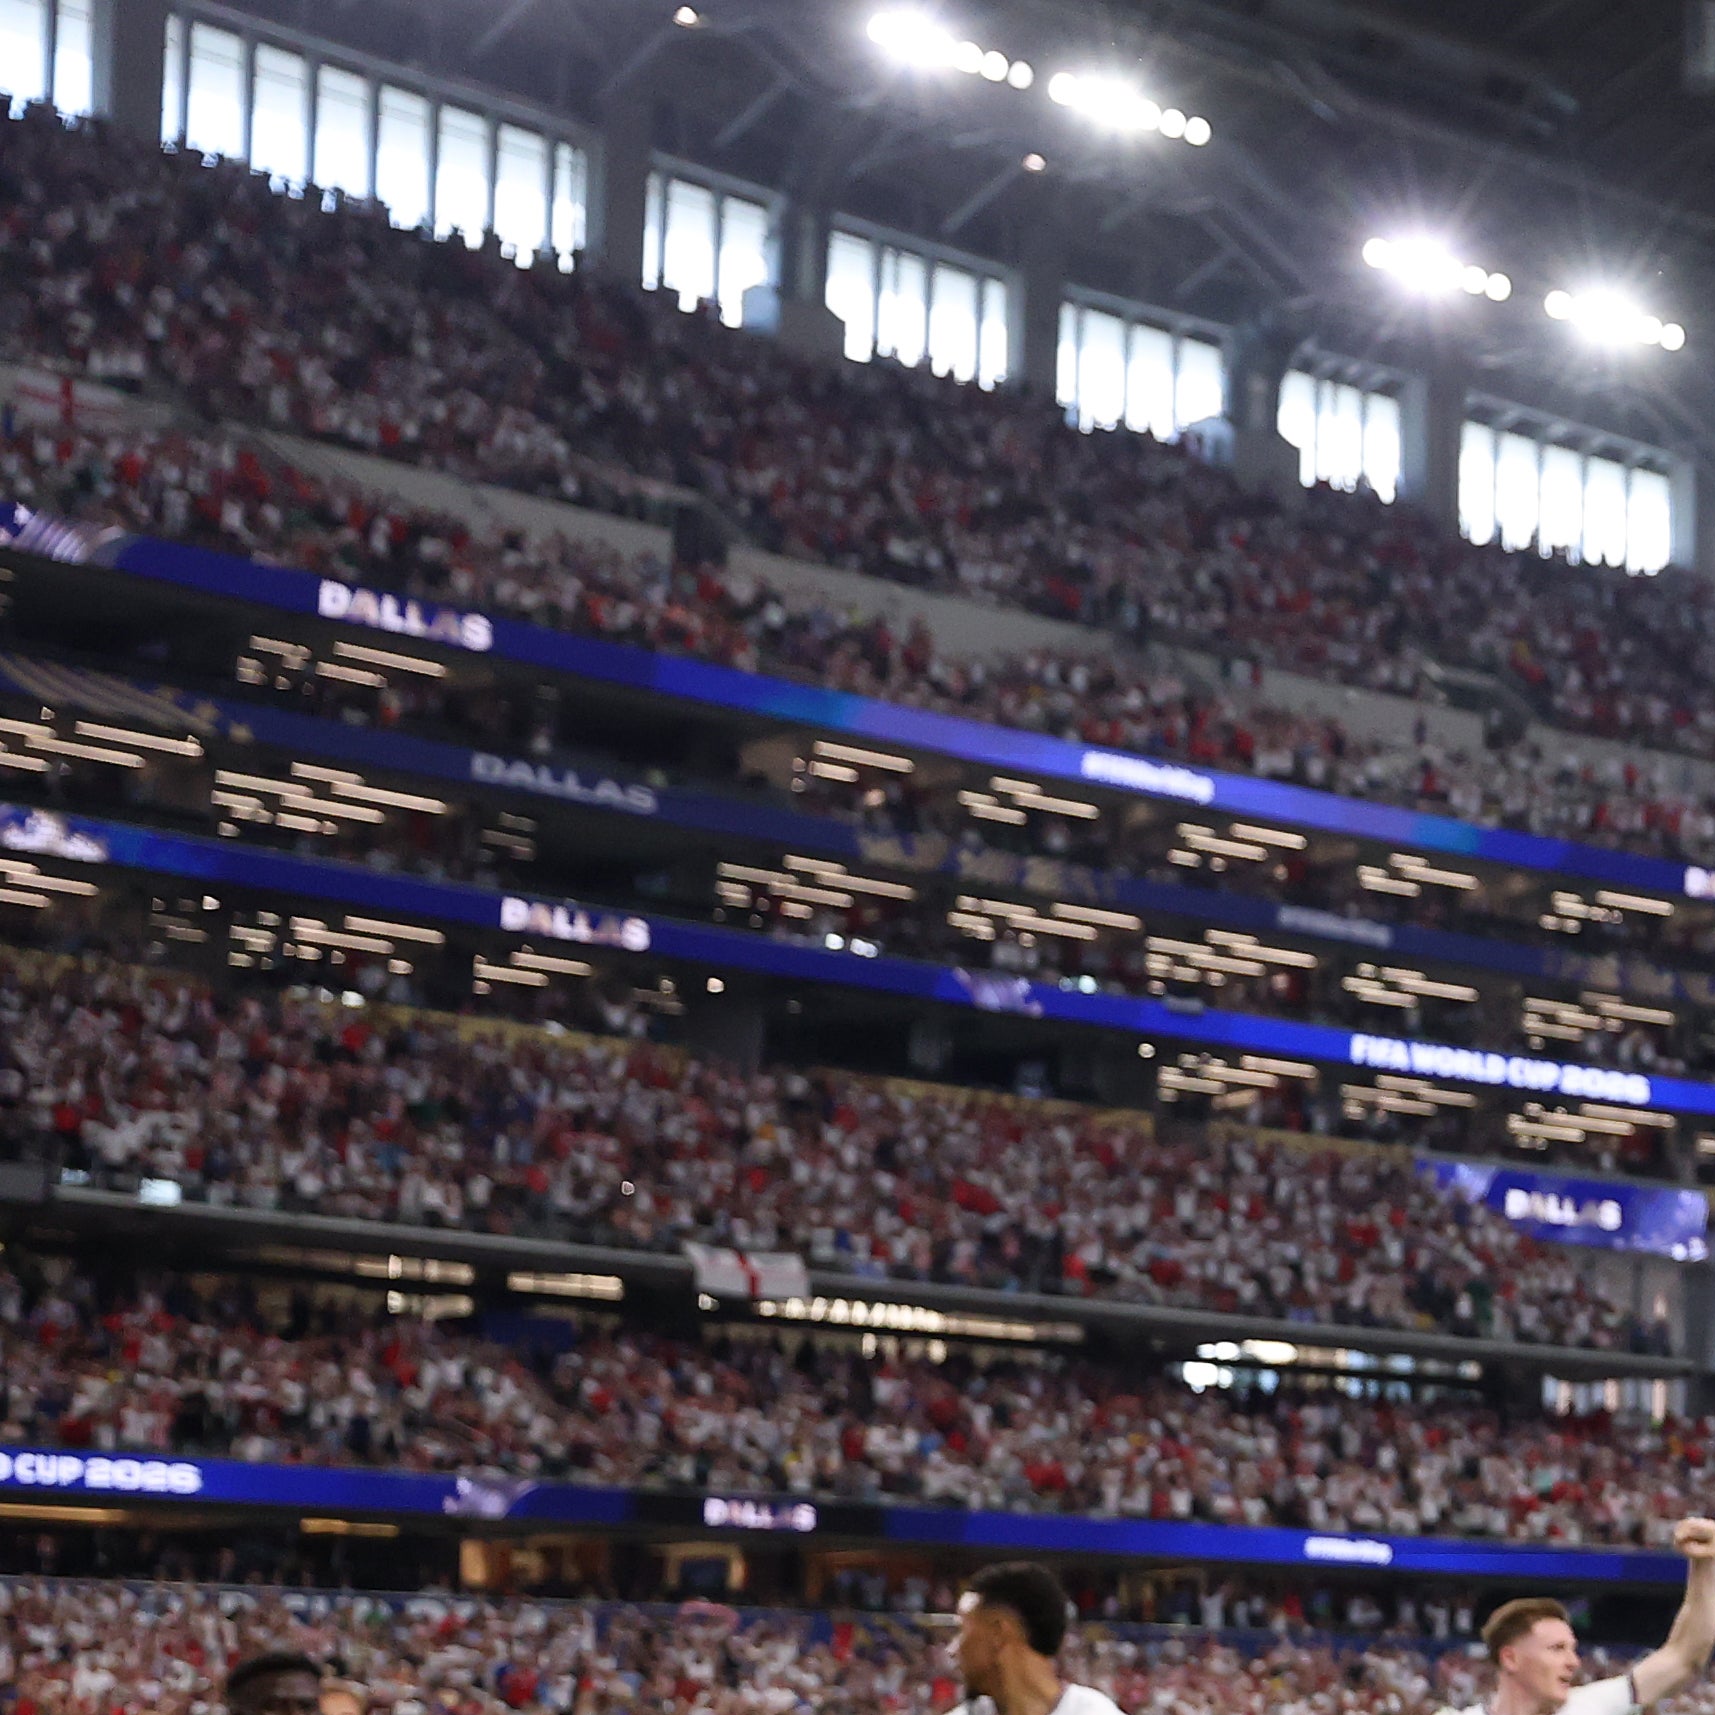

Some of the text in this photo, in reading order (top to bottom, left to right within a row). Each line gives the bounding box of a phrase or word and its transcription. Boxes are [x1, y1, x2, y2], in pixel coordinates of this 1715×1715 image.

[319, 579, 494, 652] DALLAS
[500, 897, 650, 952] DALLAS
[14, 1453, 84, 1486] CUP
[84, 1457, 203, 1494] 2026
